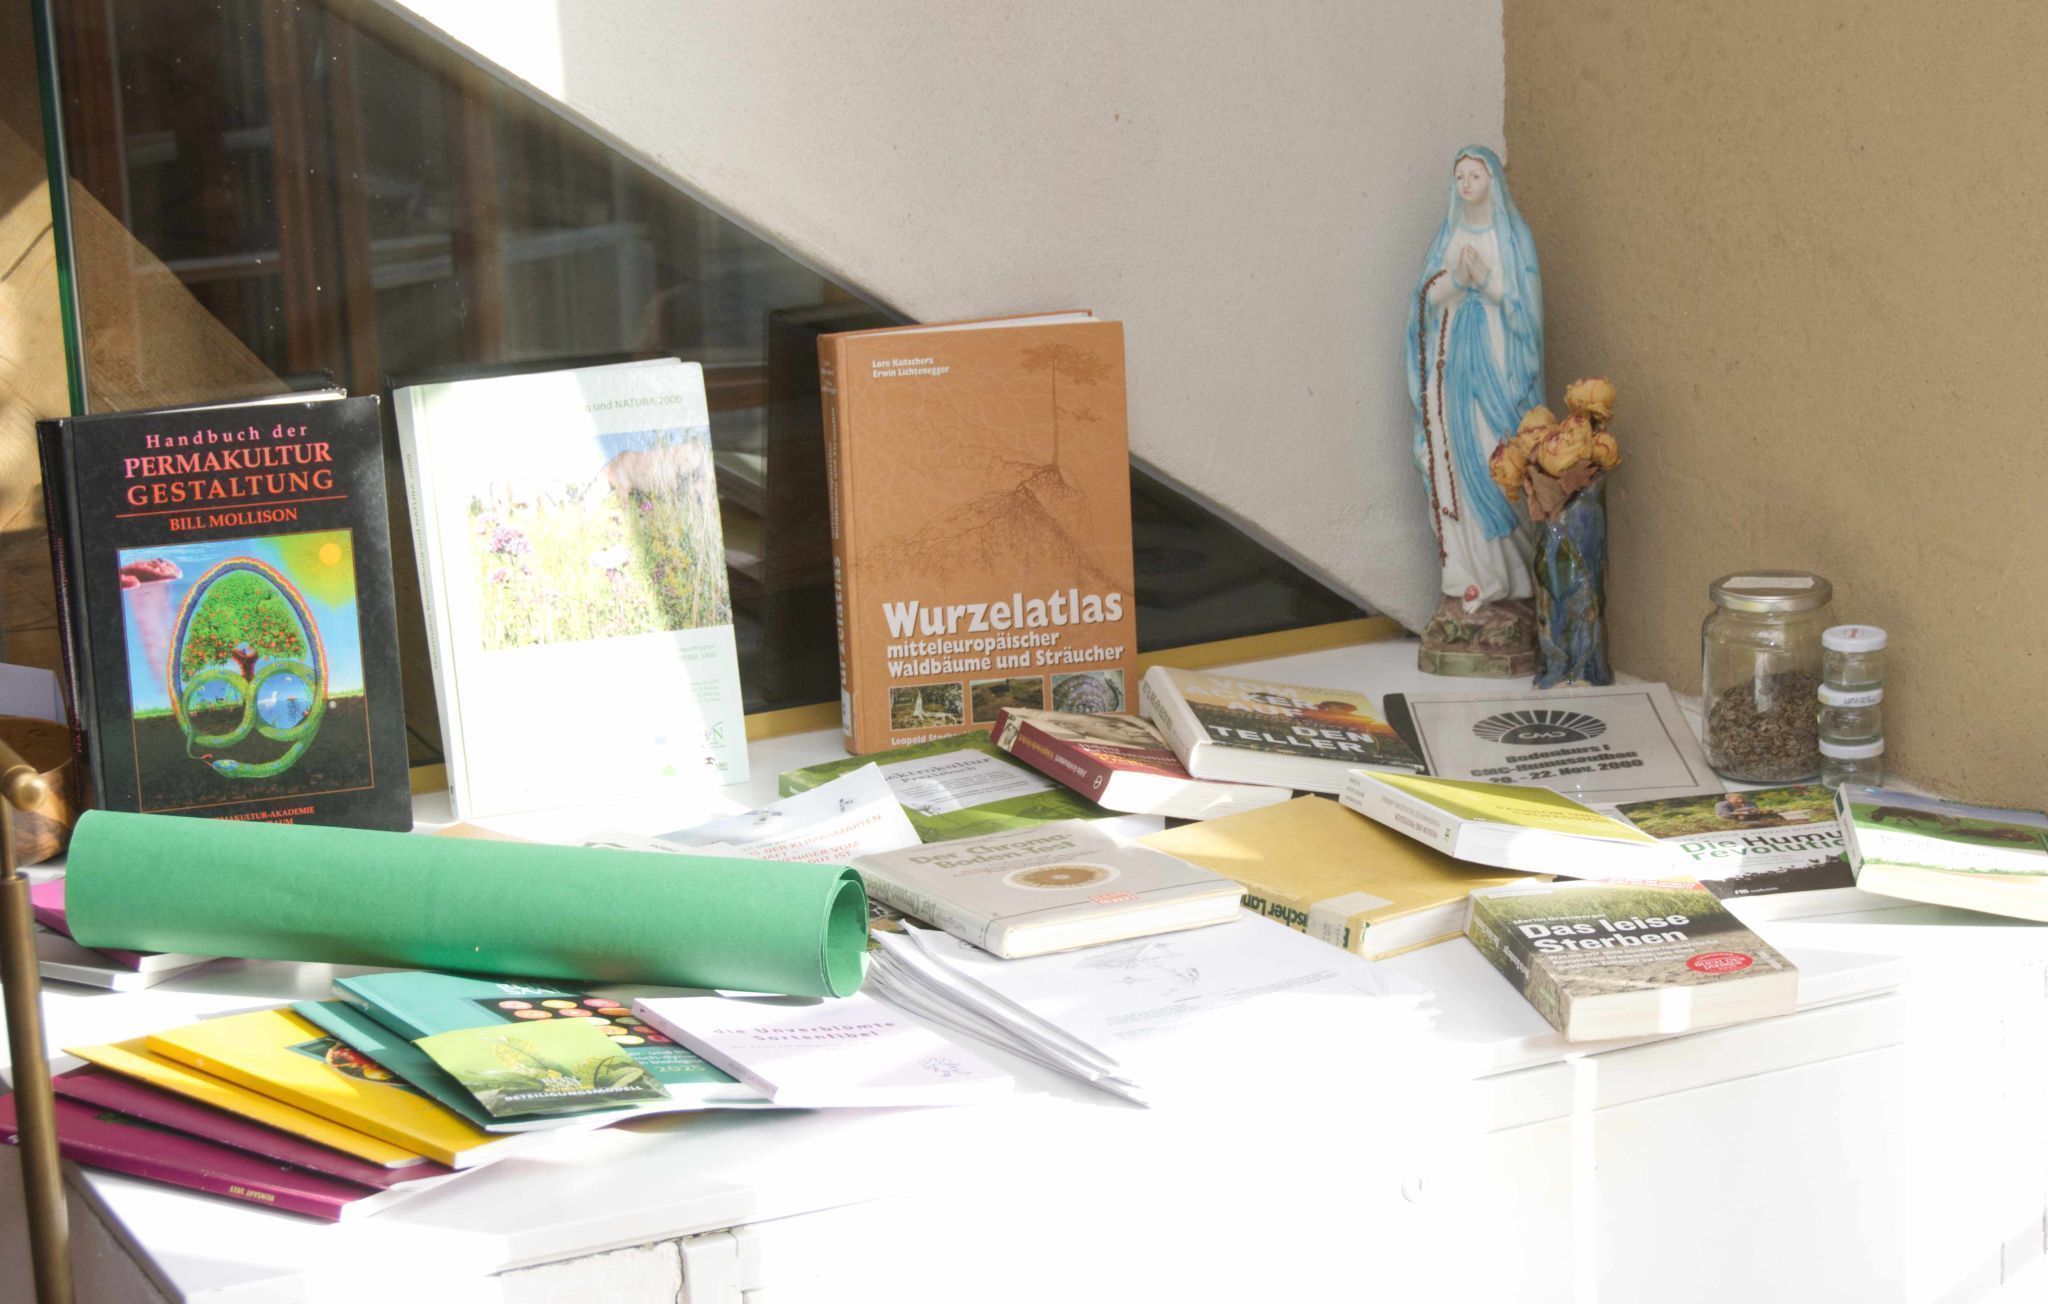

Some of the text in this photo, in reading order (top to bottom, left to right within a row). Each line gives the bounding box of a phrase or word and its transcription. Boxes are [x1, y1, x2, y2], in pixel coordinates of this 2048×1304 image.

[873, 366, 949, 378] Erwin Lichtenegger
[615, 397, 657, 408] NATURA
[145, 424, 308, 449] Handbuch der
[124, 442, 333, 478] PERMAKULTUR
[127, 469, 334, 506] GESTALTUNG
[169, 508, 298, 532] BILL MOLLISON
[833, 555, 847, 686] urzelatlas
[882, 588, 1124, 639] Wurzelatlas
[887, 630, 1060, 659] mitteleuropäischer
[888, 645, 1124, 678] Waldbäume und Sträucher
[1227, 701, 1304, 719] AUF
[891, 735, 927, 746] Leopold
[1208, 725, 1366, 753] TELLER
[1291, 726, 1375, 744] DEN
[1505, 745, 1600, 763] Bodenkurs
[885, 758, 991, 781] ektrokultur
[1529, 771, 1558, 780] 22.
[1558, 766, 1595, 776] Nov.
[1598, 759, 1644, 771] 2000
[909, 851, 957, 865] Der
[965, 833, 1074, 855] Chroma-
[1679, 830, 1842, 855] Die Humu
[1691, 839, 1846, 861] revolutio
[1240, 894, 1309, 934] ischer Lan
[1513, 917, 1547, 925] Martin
[1518, 922, 1597, 940] Das
[1598, 914, 1691, 932] leise
[1533, 930, 1690, 953] Sterben
[753, 1031, 880, 1041] Sortenfibel
[755, 1021, 896, 1034] Unverblümte
[503, 1084, 644, 1102] BETEILIGUNGSMODELL
